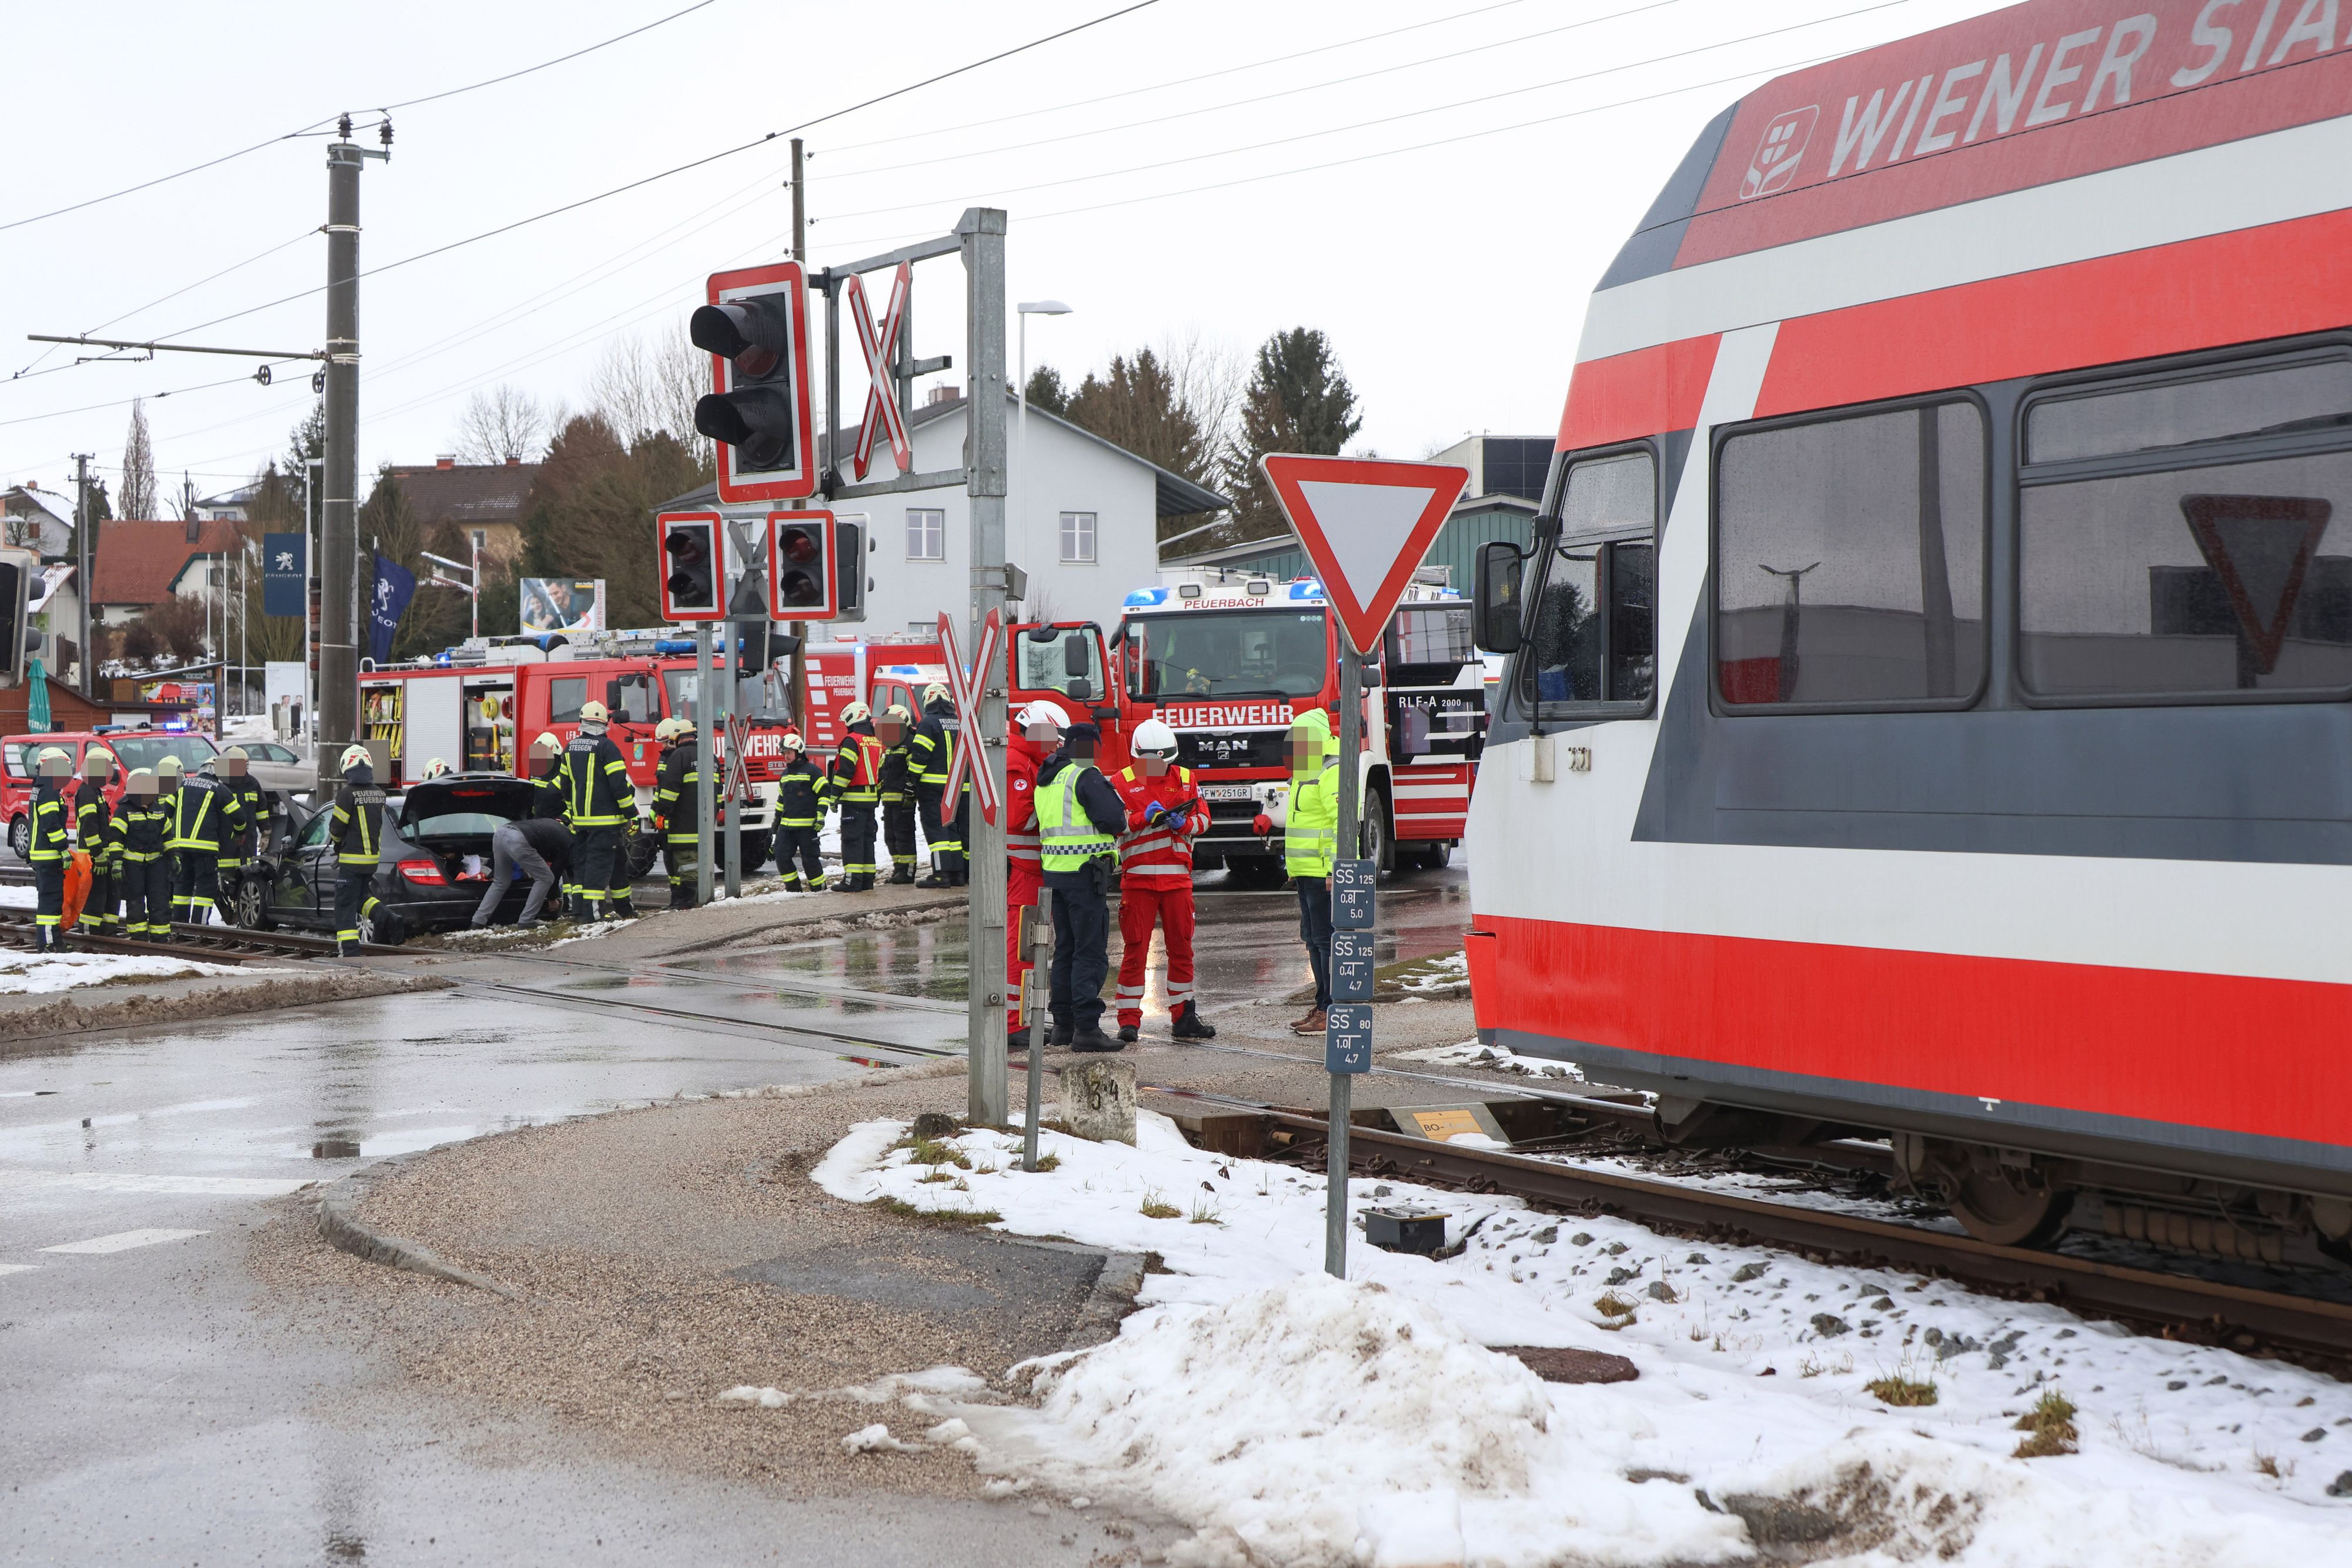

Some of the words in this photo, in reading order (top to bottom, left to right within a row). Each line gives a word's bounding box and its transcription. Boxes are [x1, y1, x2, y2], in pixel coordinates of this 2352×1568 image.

[1827, 13, 2157, 178] WIENER
[2169, 0, 2352, 88] STA
[1184, 597, 1264, 609] PEUERBACH
[824, 676, 855, 686] FEUERWEHR
[833, 688, 856, 696] PEUERBACH
[1399, 696, 1436, 708] RLF-A
[1442, 698, 1461, 707] 2000
[1152, 704, 1294, 727] FEUERWEHR
[1198, 740, 1248, 751] MAN
[183, 781, 212, 789] STEEGEN
[1204, 789, 1215, 798] FW
[1335, 869, 1354, 884] SS
[1359, 874, 1374, 884] 125
[1350, 909, 1363, 919] 5,0
[1335, 941, 1353, 956] SS
[1358, 947, 1373, 957] 125
[1349, 981, 1362, 991] 4,7
[1330, 1014, 1349, 1029] SS
[1359, 1019, 1371, 1029] 80
[1345, 1053, 1359, 1064] 4,7
